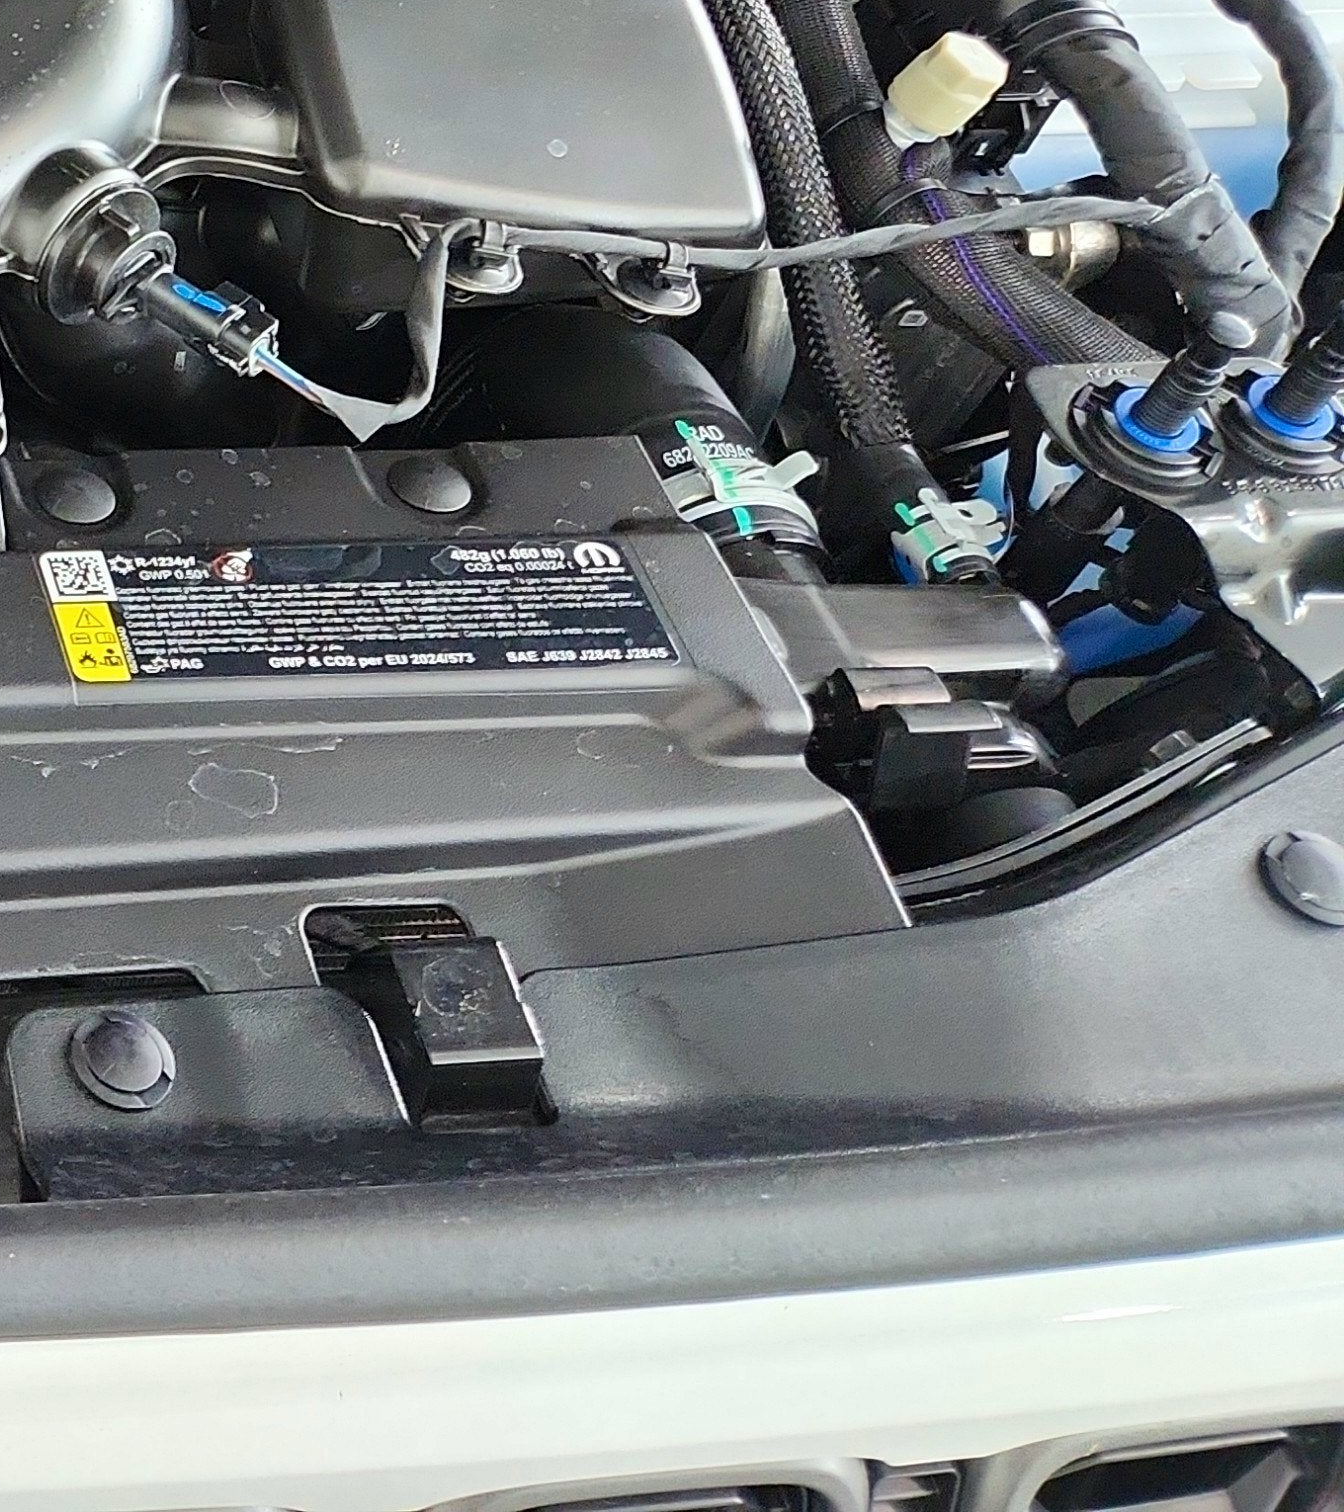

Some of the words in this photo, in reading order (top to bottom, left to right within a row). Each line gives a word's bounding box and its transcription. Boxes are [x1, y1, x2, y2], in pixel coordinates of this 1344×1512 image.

[662, 443, 755, 468] 6822209AC
[463, 561, 496, 573] CO2
[496, 562, 515, 574] eq
[138, 569, 172, 581] GWP
[173, 568, 211, 580] 0.501
[268, 655, 307, 669] GWP
[307, 655, 323, 668] &
[322, 654, 358, 667] CO2
[357, 656, 384, 670] per
[383, 653, 410, 666] EU
[504, 650, 540, 663] SAE
[169, 657, 205, 670] PAG
